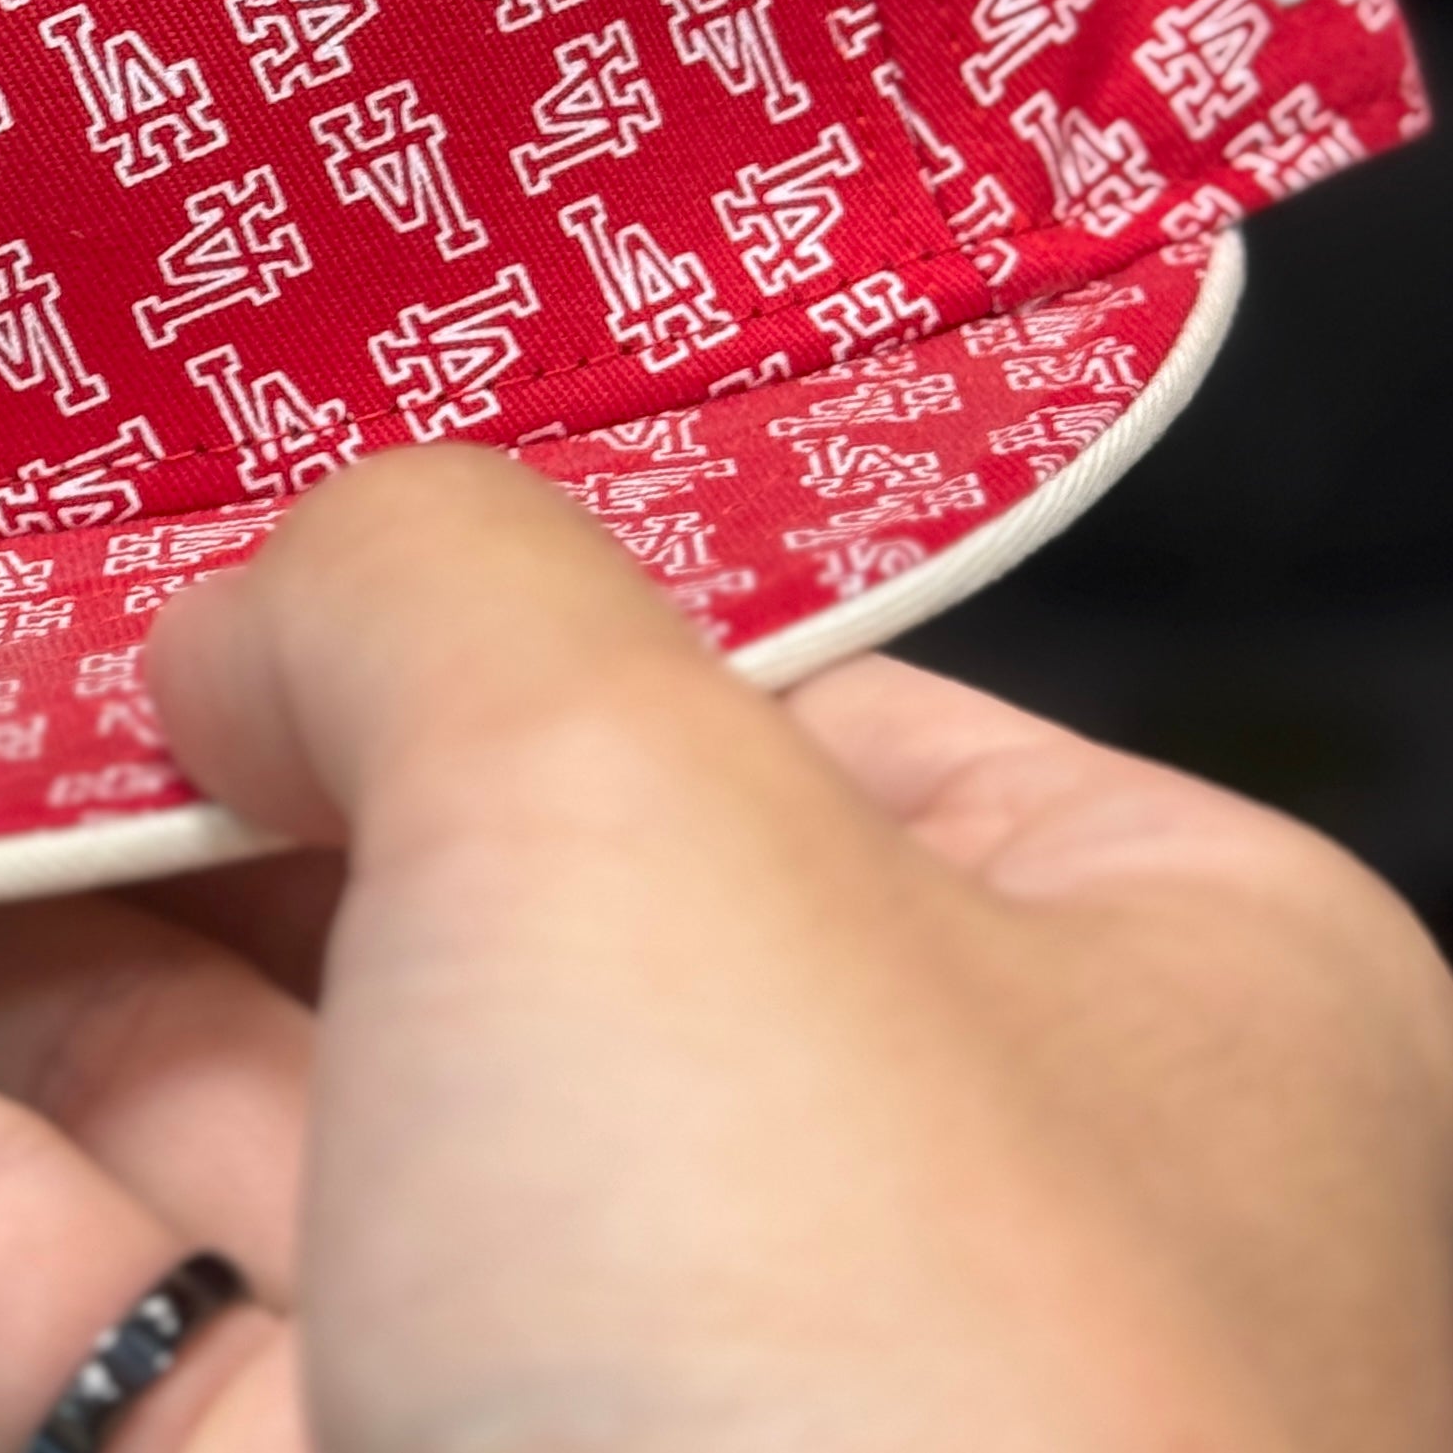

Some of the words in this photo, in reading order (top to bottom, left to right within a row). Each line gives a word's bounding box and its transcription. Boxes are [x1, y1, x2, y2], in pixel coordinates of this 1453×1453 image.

[38, 3, 228, 188] LA
[310, 79, 489, 262] LA
[510, 19, 662, 196] LA
[1010, 90, 1166, 236] LA
[132, 163, 313, 349] LA
[558, 195, 739, 373] LA
[711, 123, 862, 297] LA
[185, 344, 363, 498] LA
[368, 264, 541, 443] LA
